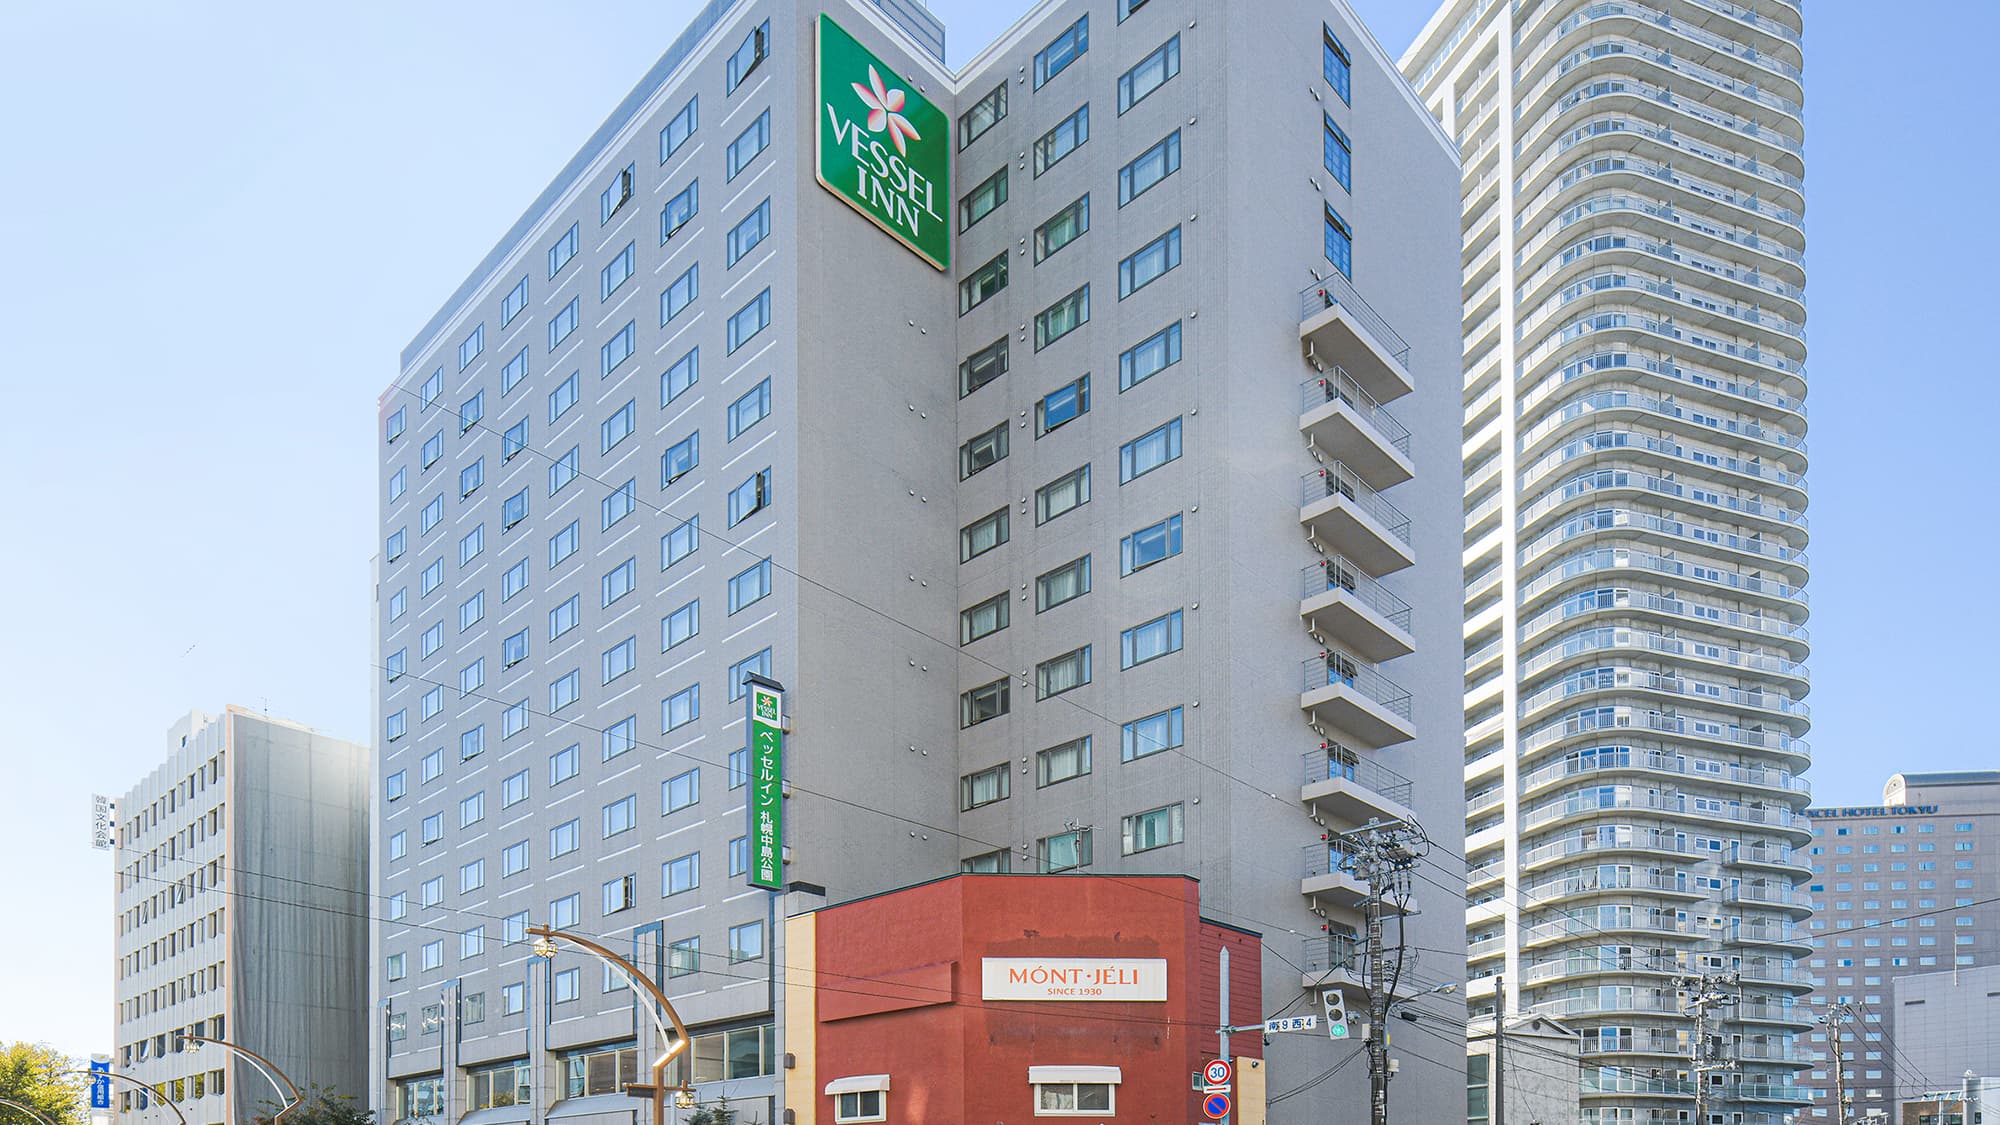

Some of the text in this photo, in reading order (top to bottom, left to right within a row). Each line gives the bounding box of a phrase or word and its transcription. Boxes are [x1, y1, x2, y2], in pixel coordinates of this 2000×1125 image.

[826, 102, 943, 222] VESSEL
[857, 164, 920, 237] INN
[756, 703, 776, 715] VESSEL
[761, 710, 773, 719] INN
[760, 731, 774, 882] ベッセルイン 札幌中島公園
[1842, 806, 1888, 817] HOTEL
[1891, 805, 1938, 815] TOKYU
[1047, 987, 1102, 996] SINCE 1930
[1210, 1066, 1226, 1079] 30
